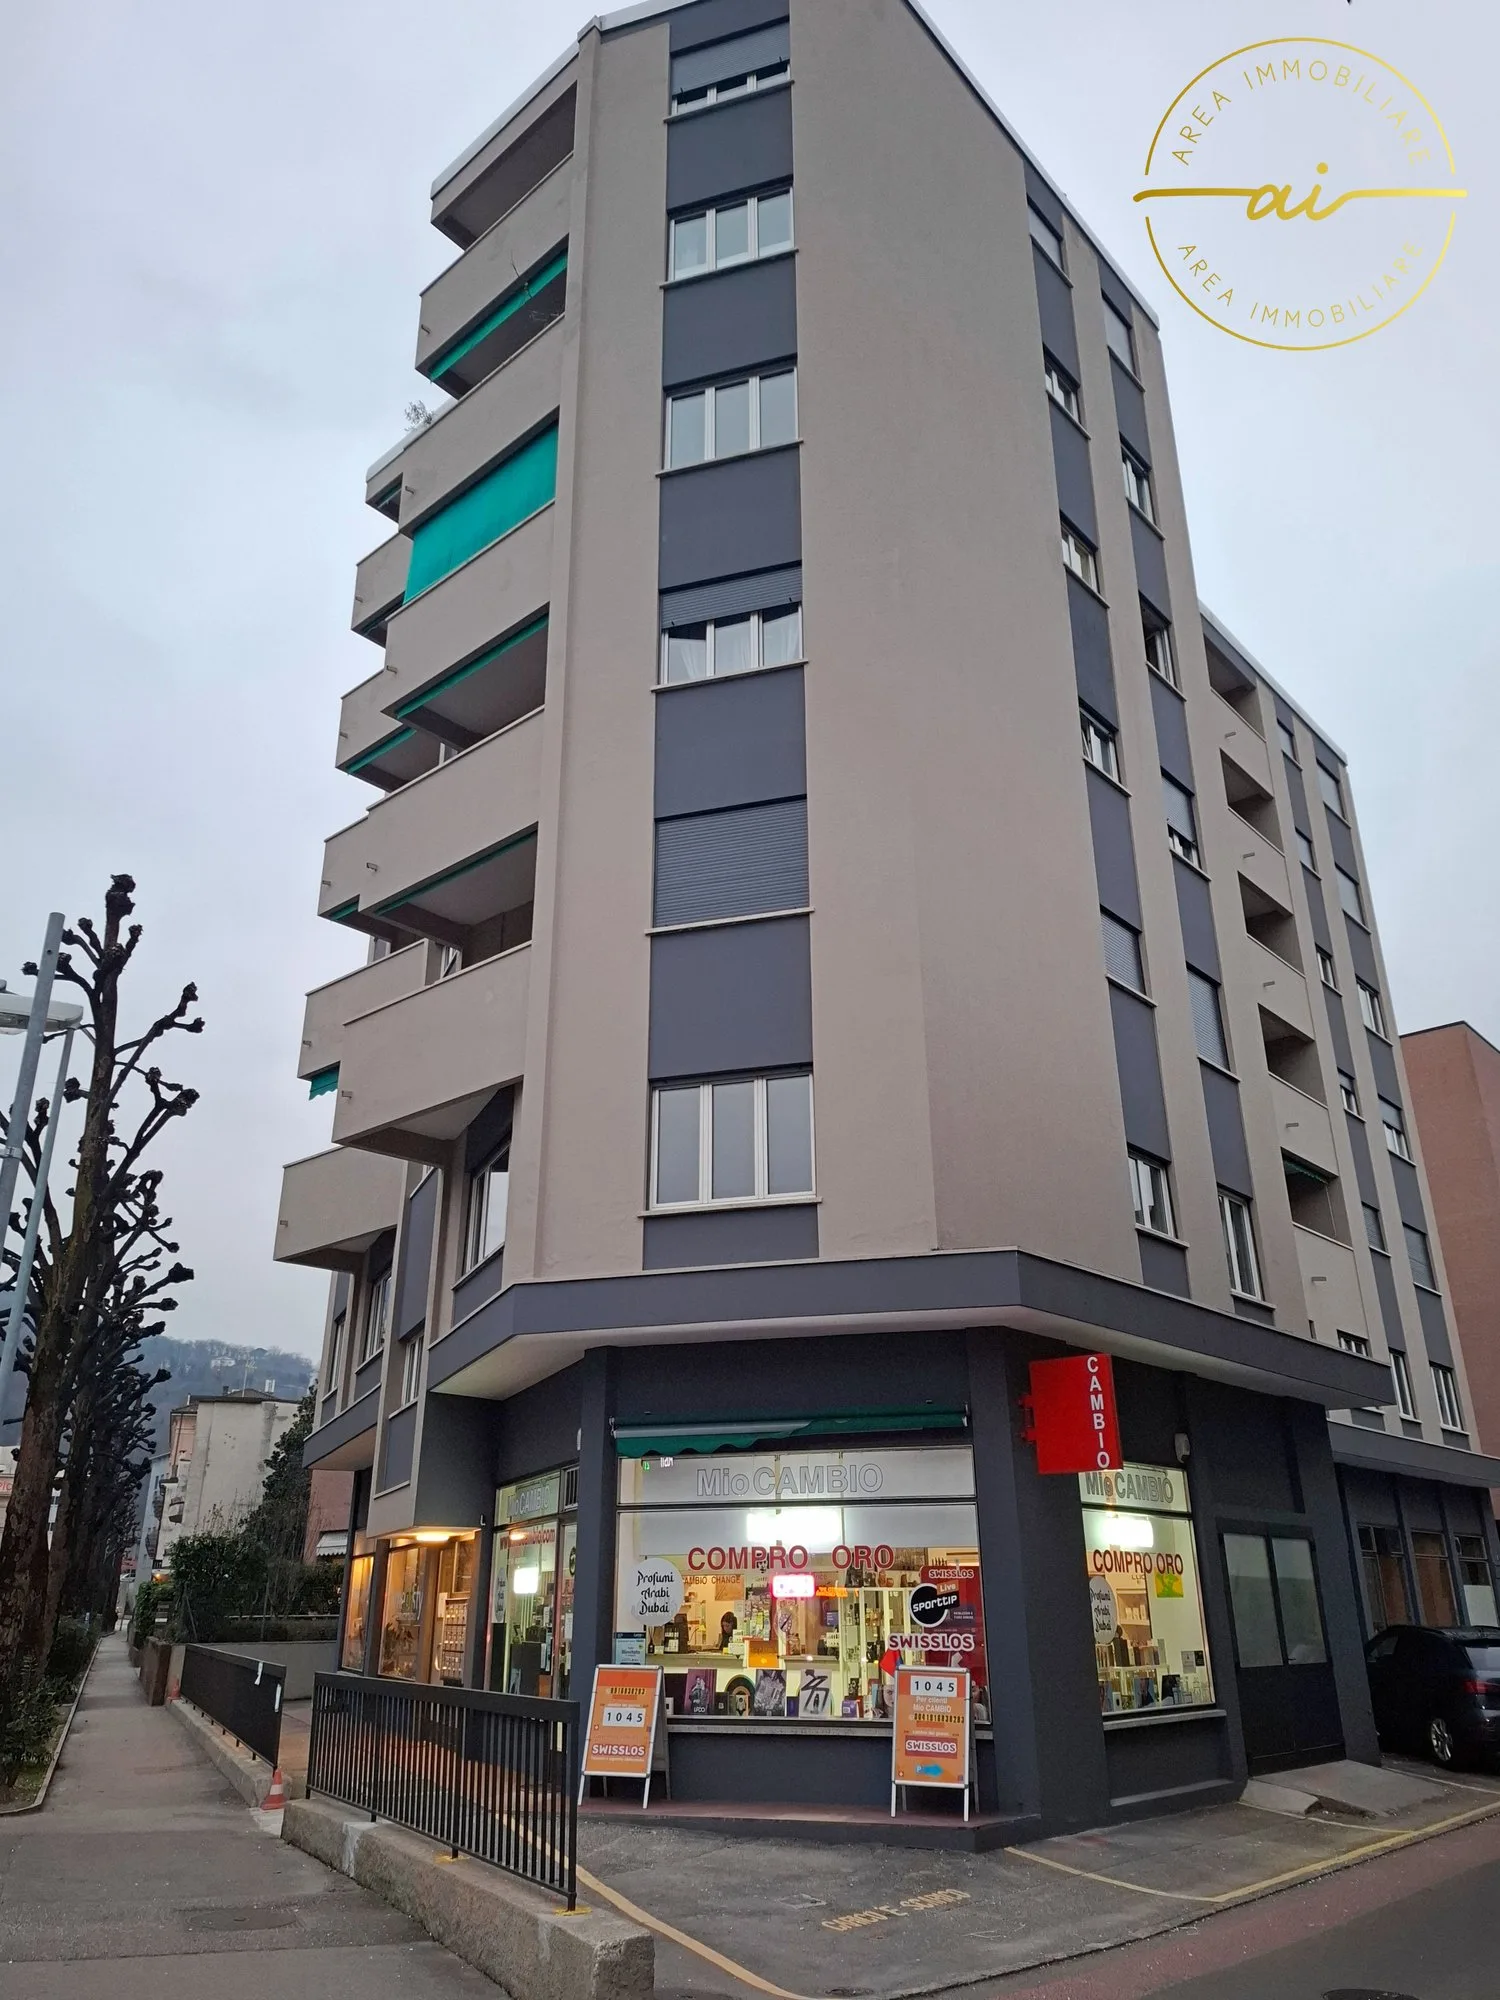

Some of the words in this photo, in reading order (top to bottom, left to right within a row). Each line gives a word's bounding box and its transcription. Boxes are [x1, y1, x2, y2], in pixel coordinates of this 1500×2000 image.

[1087, 1356, 1110, 1468] CAMBIO
[688, 1545, 809, 1571] COMPRO
[831, 1544, 895, 1570] ORO
[1093, 1549, 1153, 1573] COMPRO
[1156, 1552, 1184, 1575] ORO
[636, 1570, 675, 1586] Profumi
[711, 1575, 741, 1584] CHANGE
[929, 1569, 974, 1578] SWISSLOS
[641, 1587, 670, 1600] Arabi
[940, 1583, 956, 1592] Live
[639, 1601, 669, 1615] Dubai
[889, 1634, 975, 1650] SWISSLOS
[925, 1704, 952, 1713] CAMBIO
[592, 1745, 645, 1756] SWISSLOS
[906, 1740, 956, 1753] SWISSLOS
